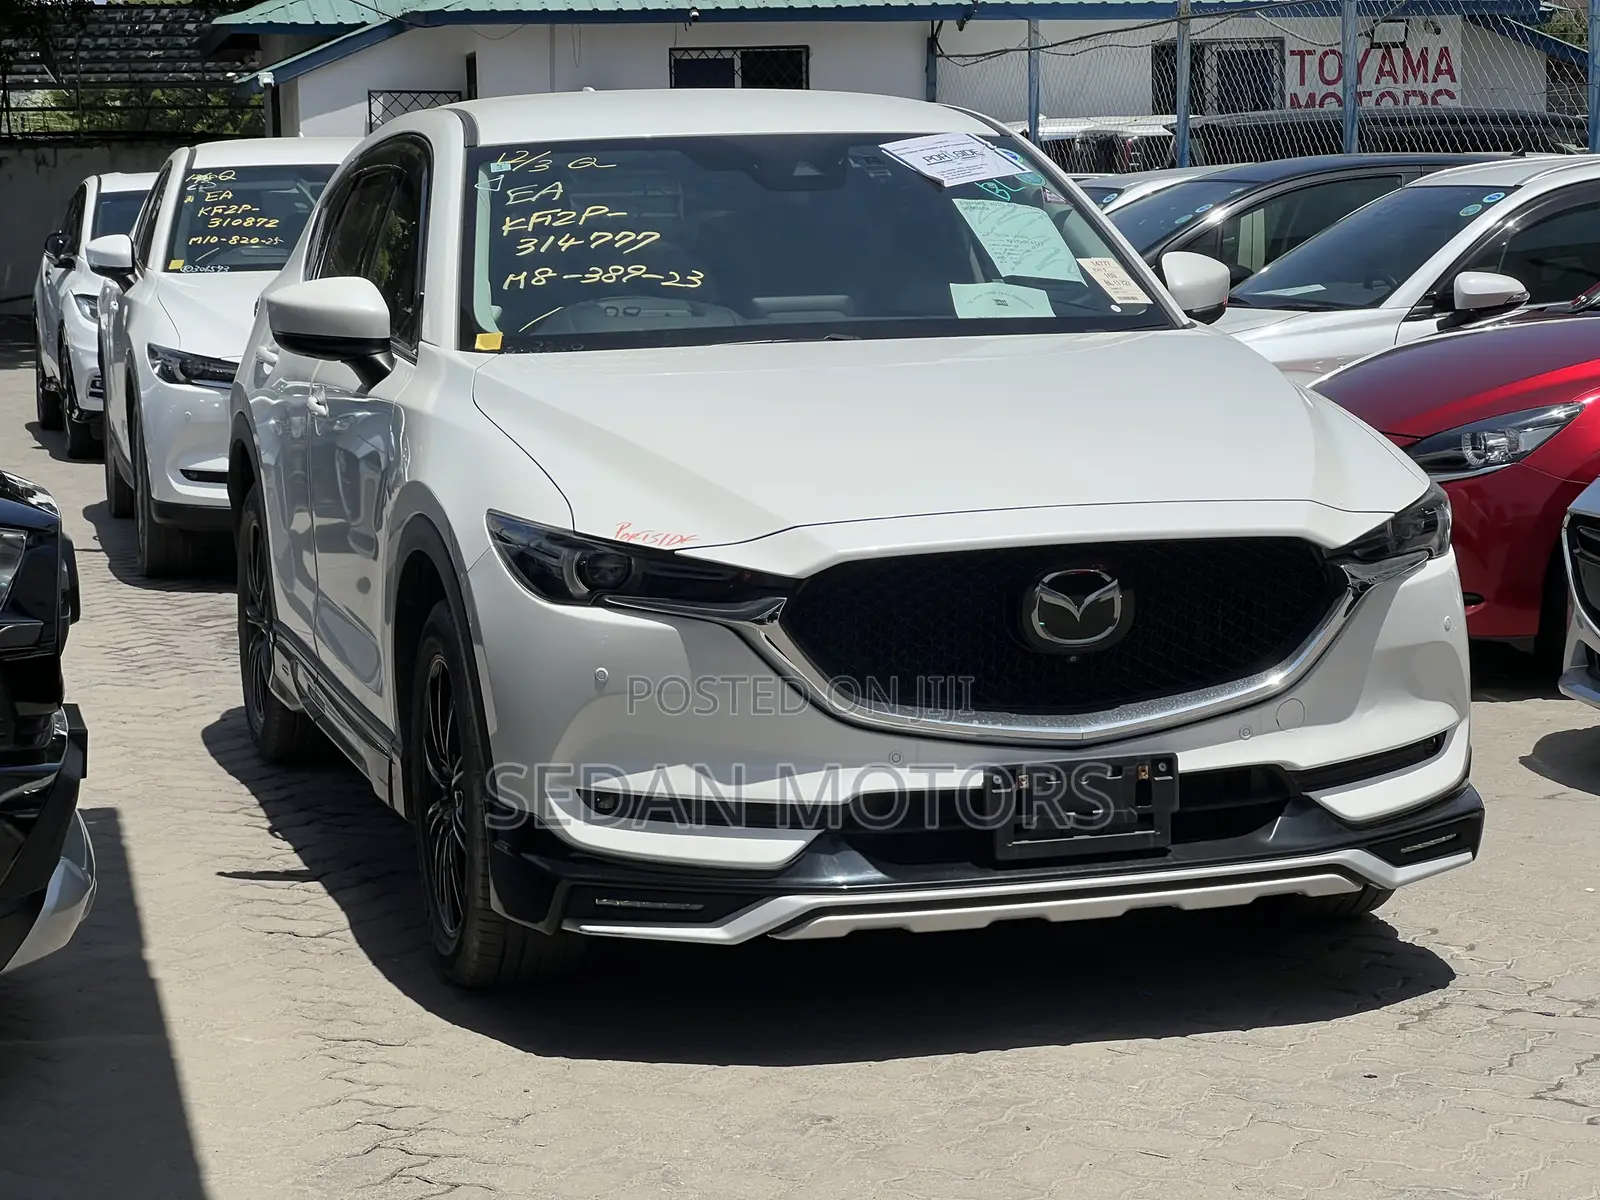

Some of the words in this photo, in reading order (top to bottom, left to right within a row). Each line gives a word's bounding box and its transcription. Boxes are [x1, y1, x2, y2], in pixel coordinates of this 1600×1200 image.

[1289, 46, 1457, 86] TOYAMA
[205, 190, 234, 201] EA
[506, 182, 563, 205] EA
[207, 216, 280, 228] 310872
[516, 232, 660, 255] 314777
